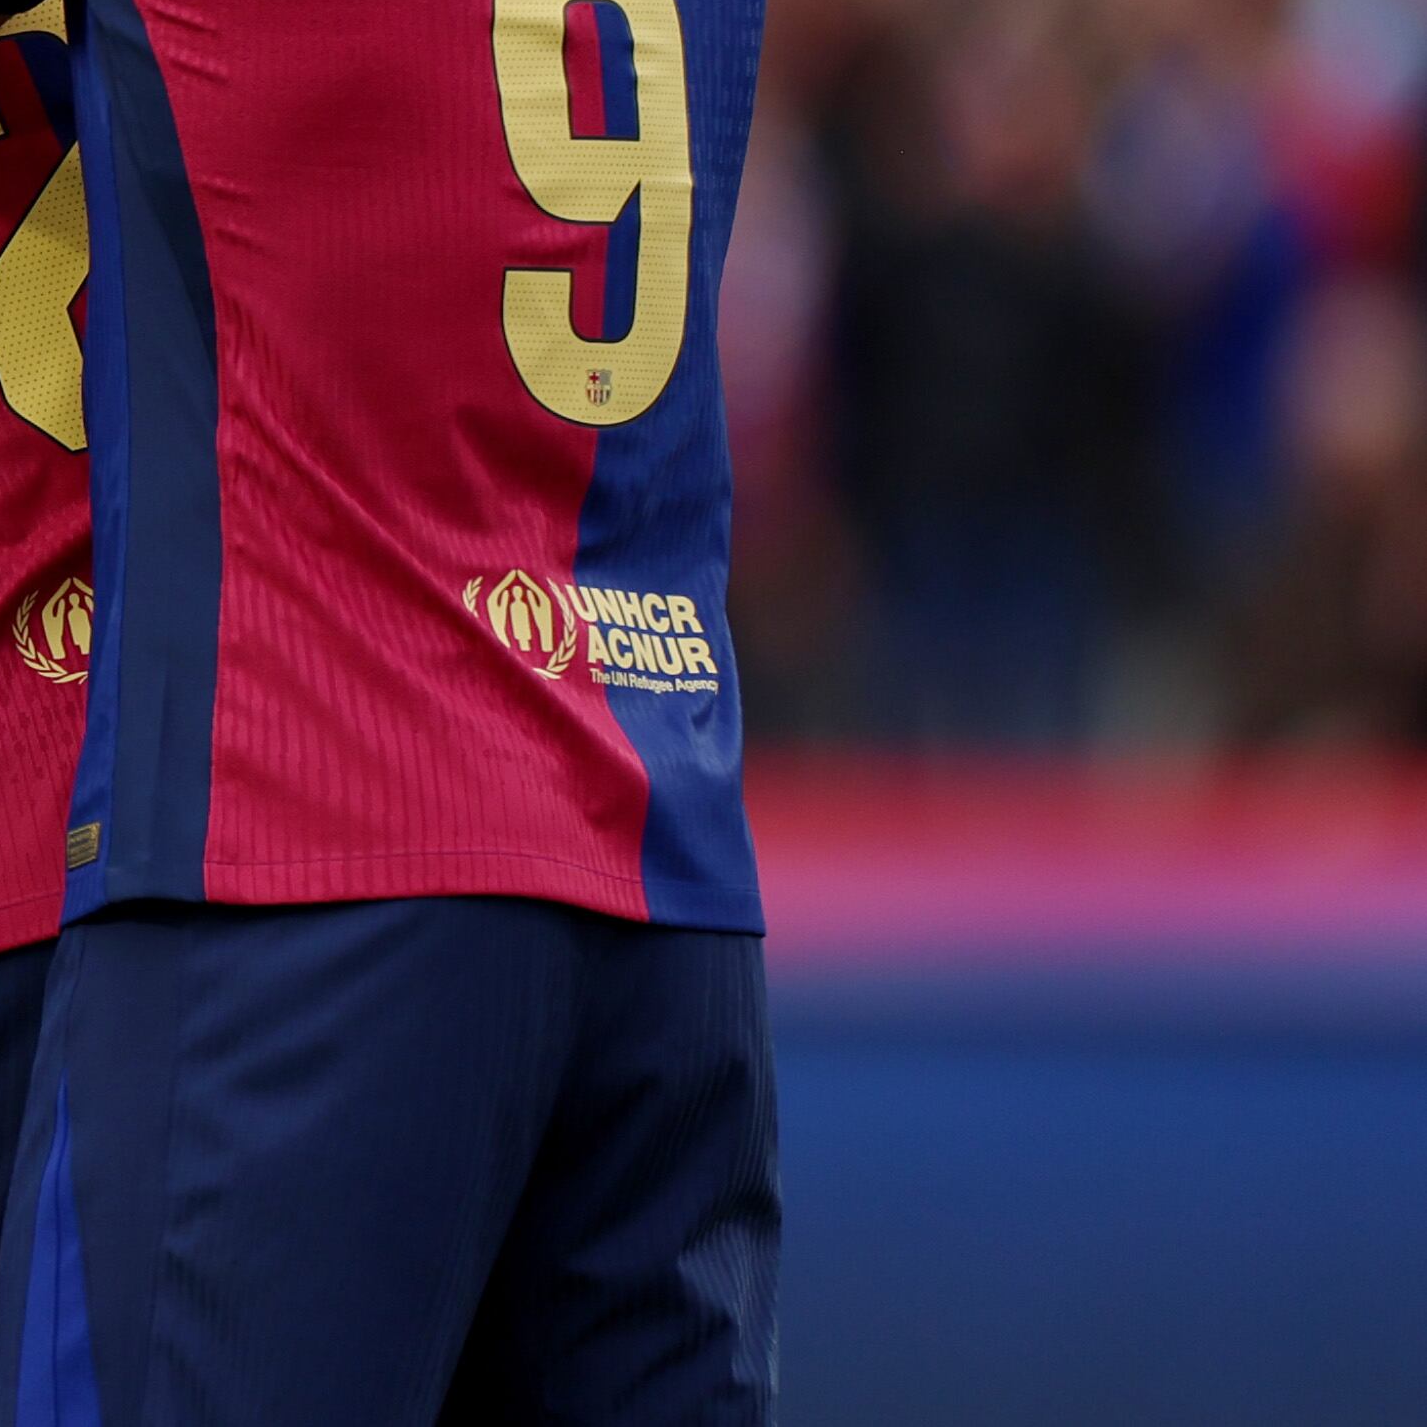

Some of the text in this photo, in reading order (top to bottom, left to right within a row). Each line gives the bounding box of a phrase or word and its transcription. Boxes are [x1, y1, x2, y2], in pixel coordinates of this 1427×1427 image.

[565, 584, 704, 634] UNHCR
[587, 624, 718, 676] ACNUR
[589, 668, 610, 685] The
[611, 671, 631, 688] UN
[630, 674, 674, 694] Refugee
